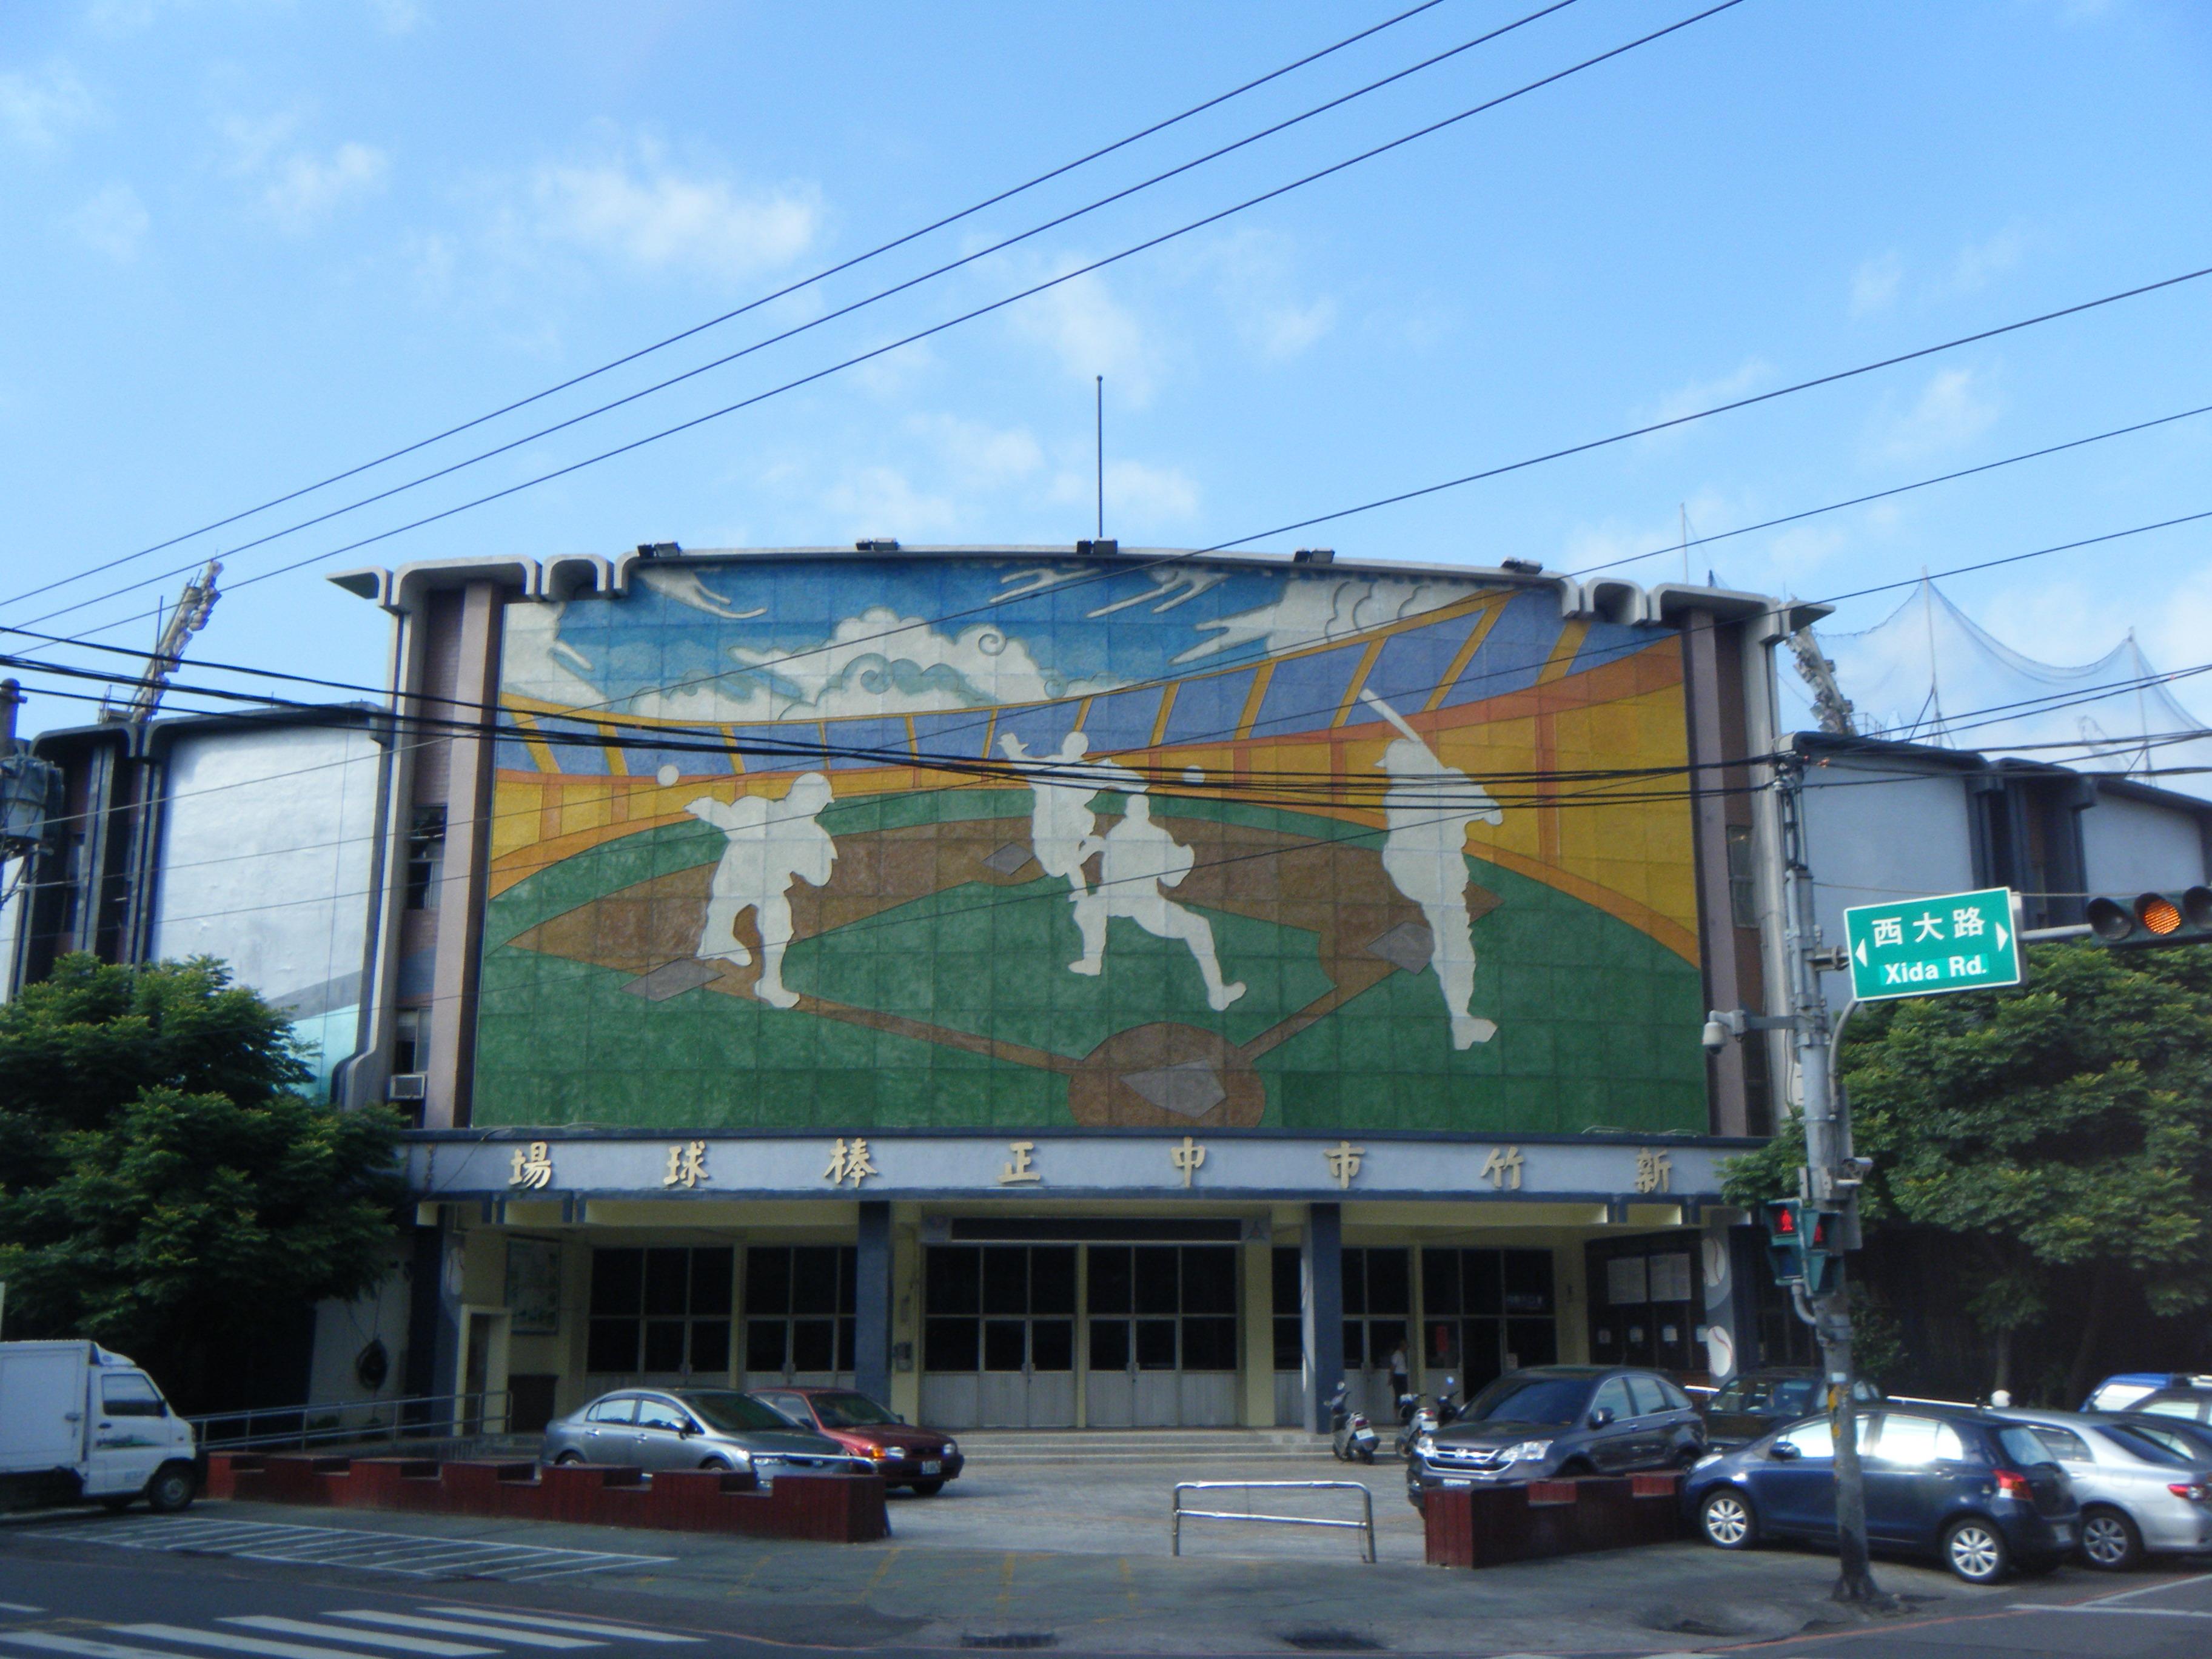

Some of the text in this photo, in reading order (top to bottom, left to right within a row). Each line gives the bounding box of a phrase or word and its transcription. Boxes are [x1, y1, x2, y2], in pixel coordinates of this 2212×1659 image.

[1871, 907, 1985, 948] 西大路
[1884, 954, 1988, 985] Xida Rd.
